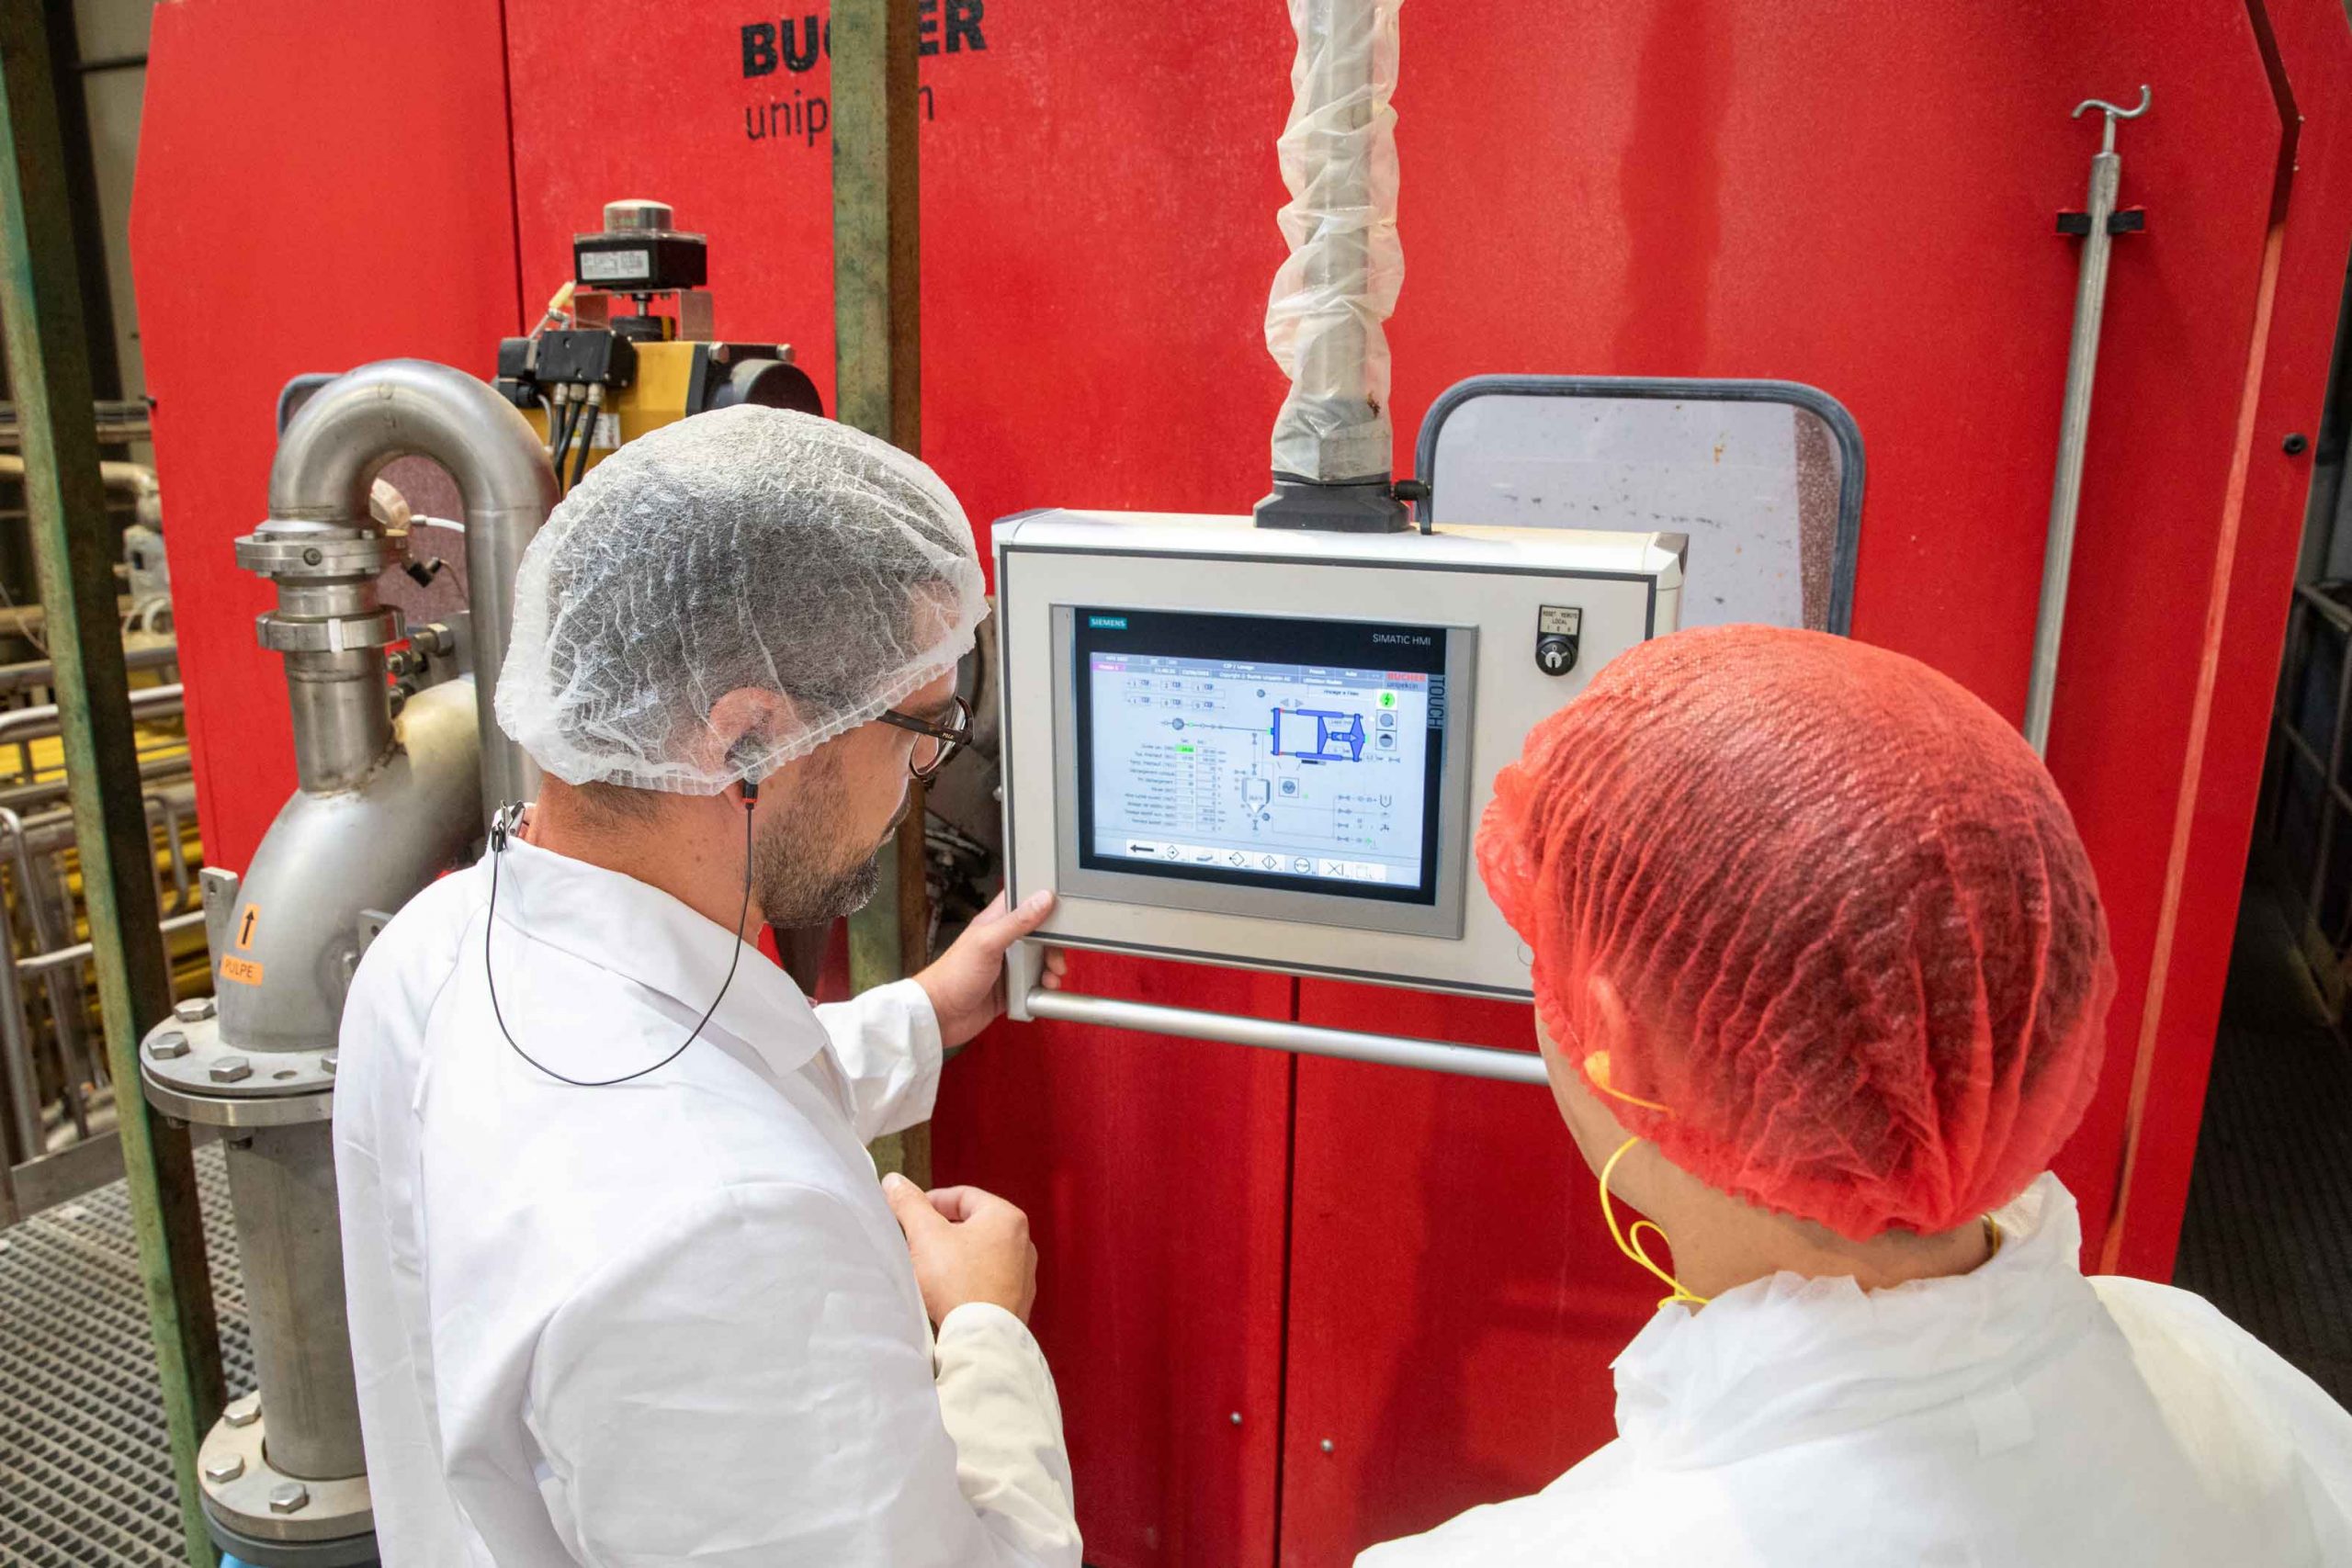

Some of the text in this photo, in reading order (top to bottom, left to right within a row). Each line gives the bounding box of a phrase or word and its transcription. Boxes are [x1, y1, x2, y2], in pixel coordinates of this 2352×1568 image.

[741, 0, 988, 79] BUER
[745, 85, 934, 148] unipn
[1090, 618, 1125, 627] SIEMENS
[1373, 633, 1431, 646] SIMATIC HMI
[1428, 675, 1445, 728] TOUCH
[225, 959, 254, 978] PULPE
